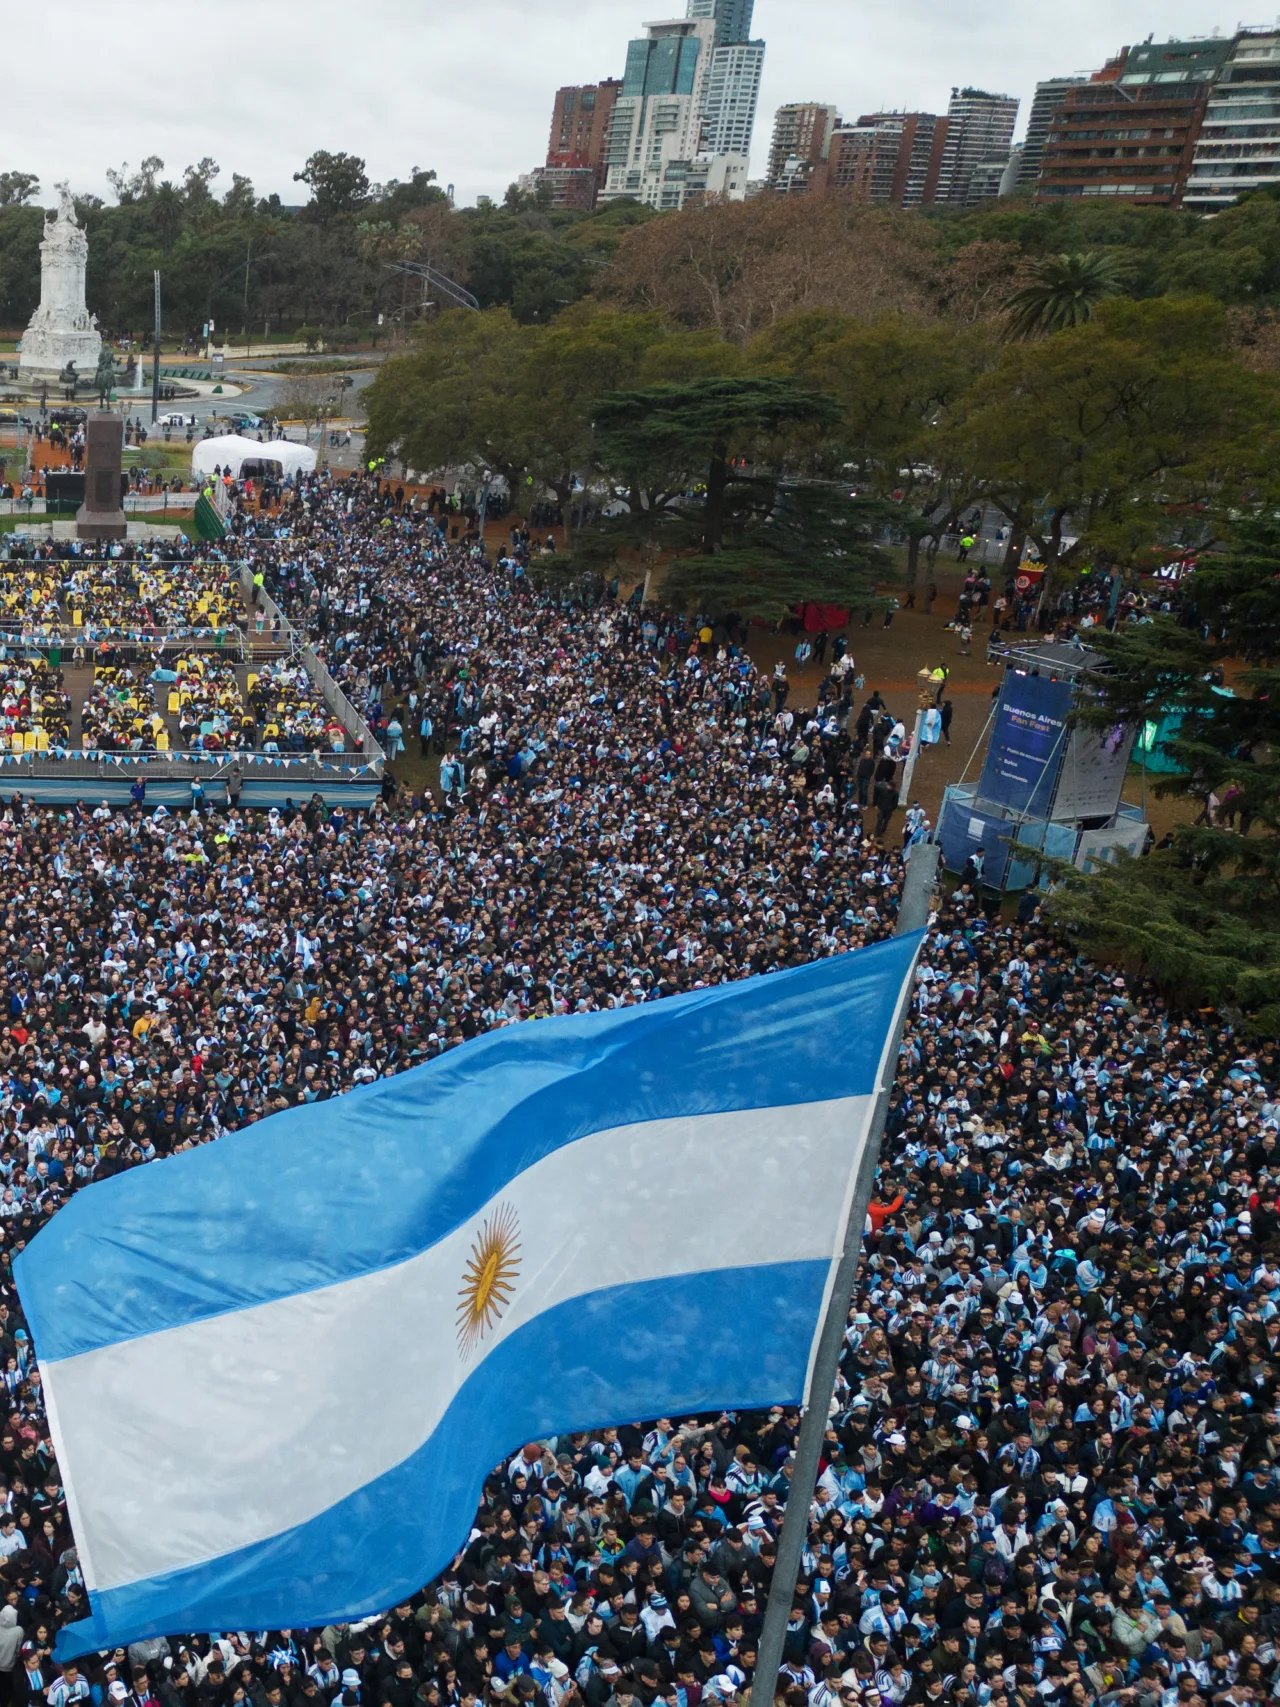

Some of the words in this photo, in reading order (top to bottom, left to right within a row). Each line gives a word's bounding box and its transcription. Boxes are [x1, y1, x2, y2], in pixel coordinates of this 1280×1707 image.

[1003, 704, 1036, 720] Buenos
[1038, 714, 1063, 728] Aires
[1012, 715, 1028, 726] Fan
[1029, 721, 1050, 731] Fest
